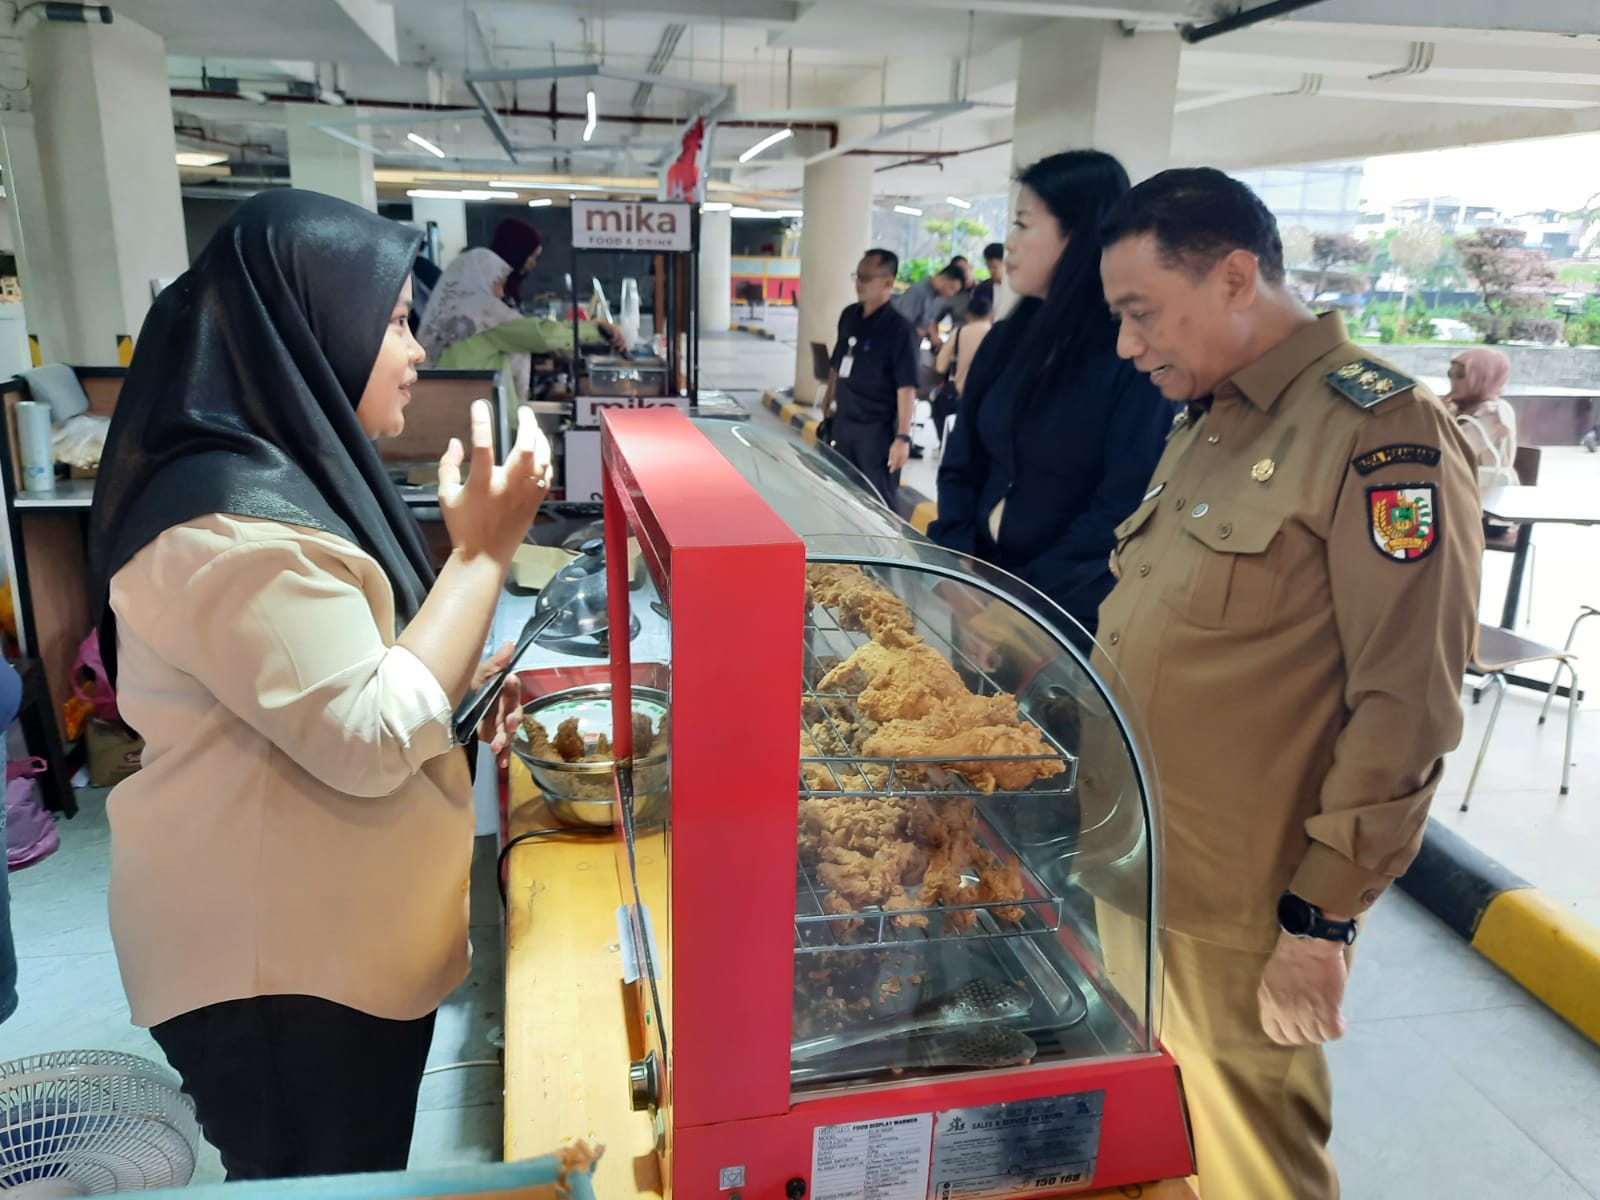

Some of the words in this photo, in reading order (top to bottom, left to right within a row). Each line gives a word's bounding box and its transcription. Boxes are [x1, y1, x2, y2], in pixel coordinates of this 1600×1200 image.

[586, 204, 677, 233] mika
[589, 237, 623, 246] FOOD
[638, 238, 673, 247] DRINK
[869, 1121, 893, 1129] DISPLAY
[894, 1117, 918, 1126] WARMER
[972, 1120, 993, 1130] SALES
[1002, 1116, 1029, 1126] SERVICE
[1031, 1112, 1064, 1122] NETWORK
[1035, 1176, 1057, 1187] 150
